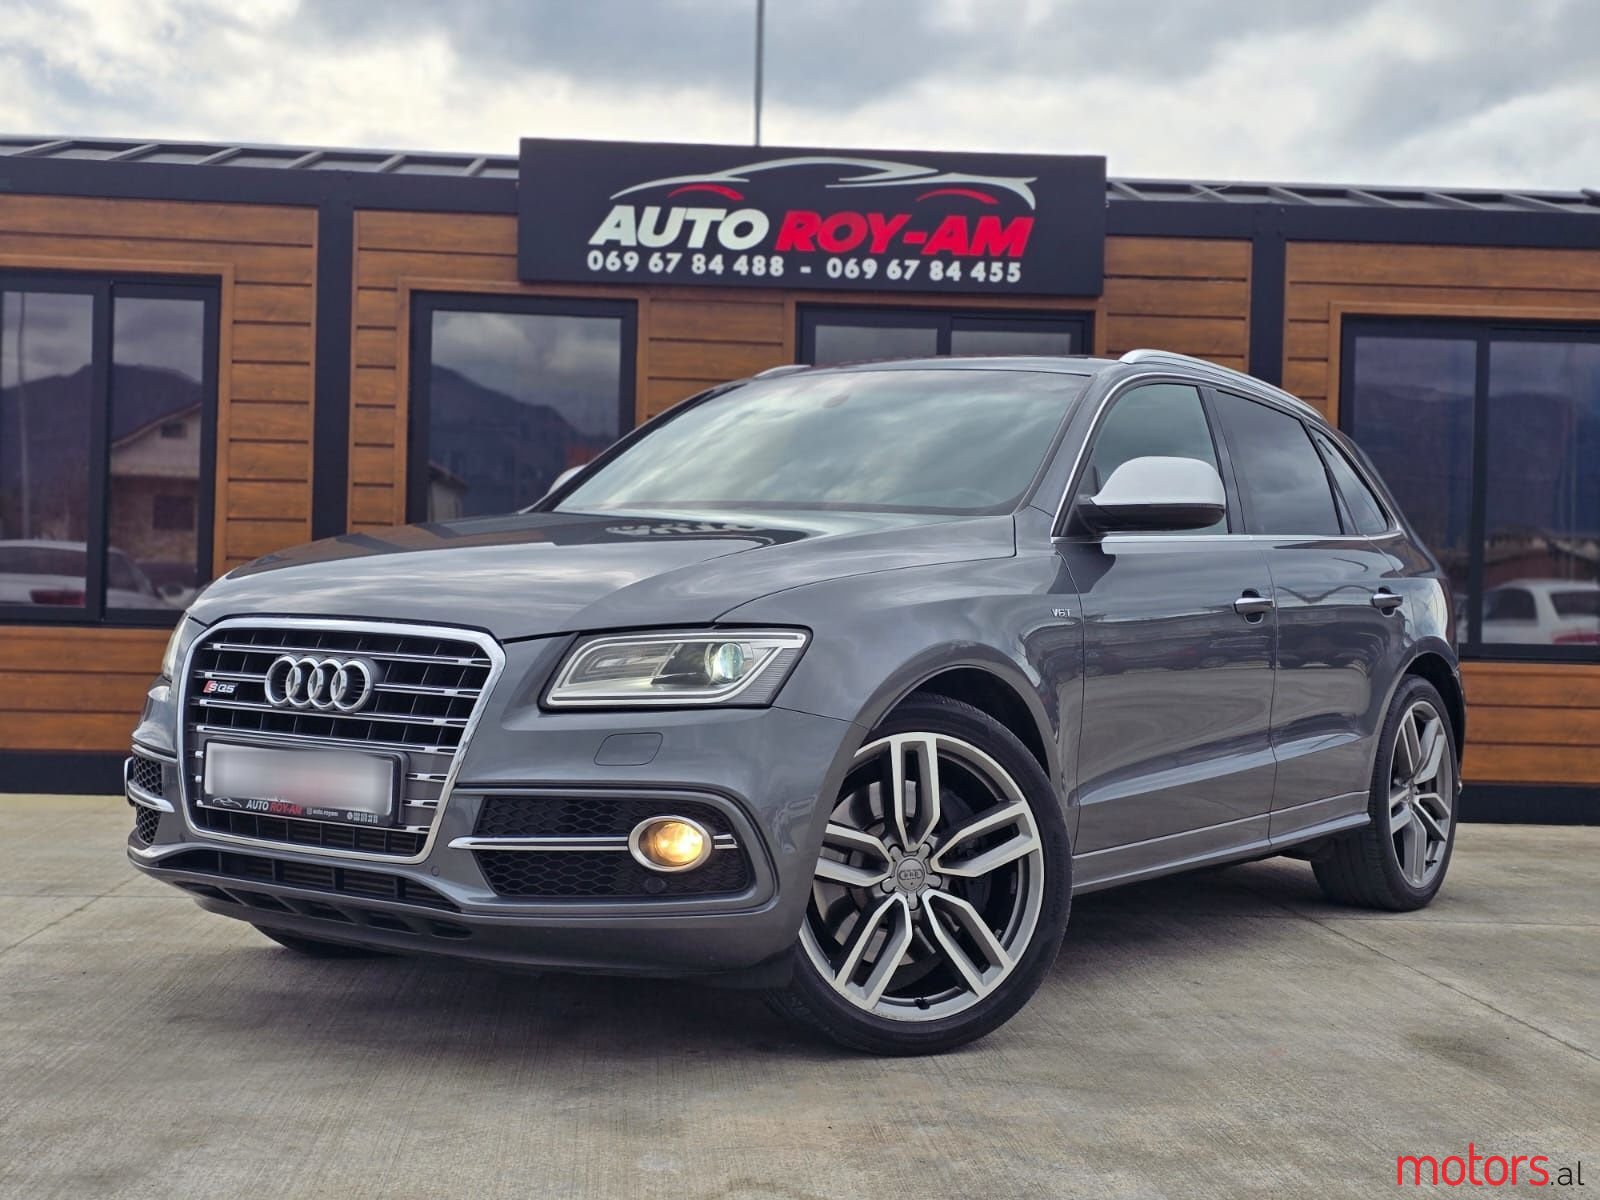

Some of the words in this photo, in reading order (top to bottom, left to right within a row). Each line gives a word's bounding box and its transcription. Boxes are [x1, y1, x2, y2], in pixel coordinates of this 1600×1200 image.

[587, 204, 770, 251] AUTO
[774, 209, 1036, 258] ROY-AM
[586, 249, 640, 273] 069
[648, 251, 683, 274] 67
[691, 253, 725, 275] 84
[732, 255, 785, 277] 488
[826, 257, 879, 280] 069
[886, 258, 921, 281] 67
[928, 260, 962, 282] 84
[969, 261, 1022, 284] 455
[203, 680, 236, 694] SQ5
[246, 799, 270, 812] AUTO
[269, 801, 304, 816] ROY-AM
